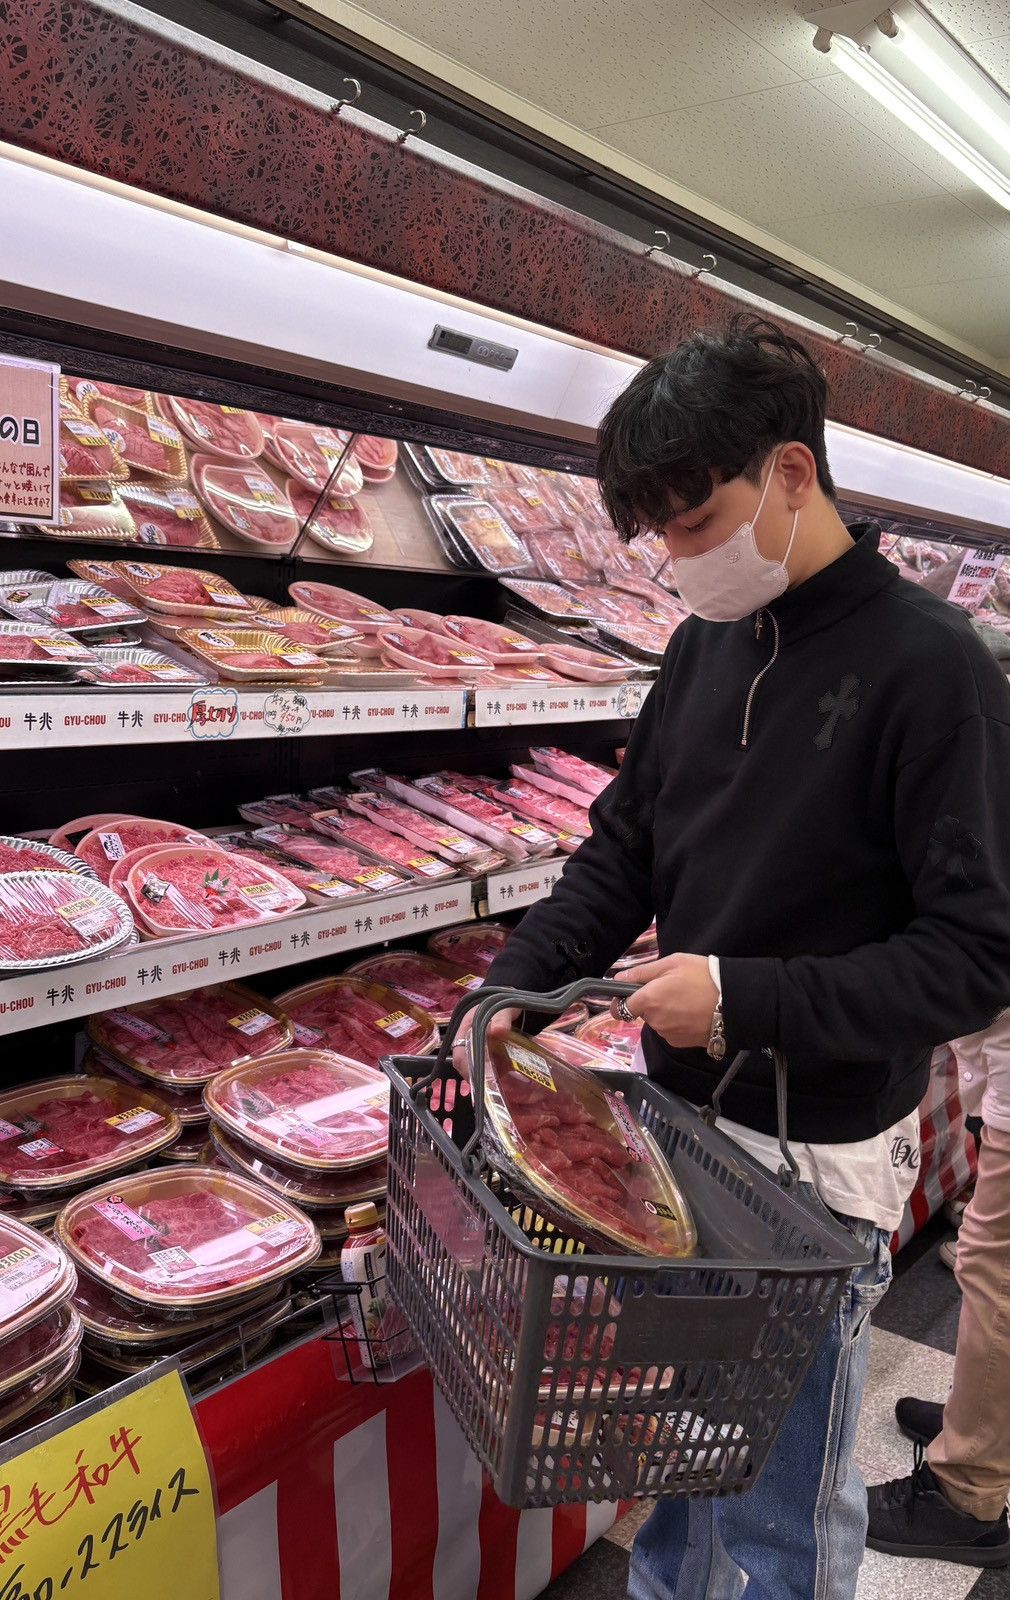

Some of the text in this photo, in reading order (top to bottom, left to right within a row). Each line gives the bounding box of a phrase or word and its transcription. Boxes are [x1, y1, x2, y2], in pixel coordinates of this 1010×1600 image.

[0, 461, 51, 478] んなで囲んで
[0, 479, 51, 494] ッと焼いて
[64, 714, 106, 726] GYU-CHOU
[154, 712, 188, 724] GYU-CHO
[367, 707, 395, 717] GYU-CHOU
[86, 976, 127, 995] GYU-CHOU
[172, 957, 209, 975] GYU-CHOU
[249, 940, 282, 957] GYU-CHOU
[317, 925, 347, 940] GYU-CHOU
[379, 911, 406, 926] GYU-CHOU
